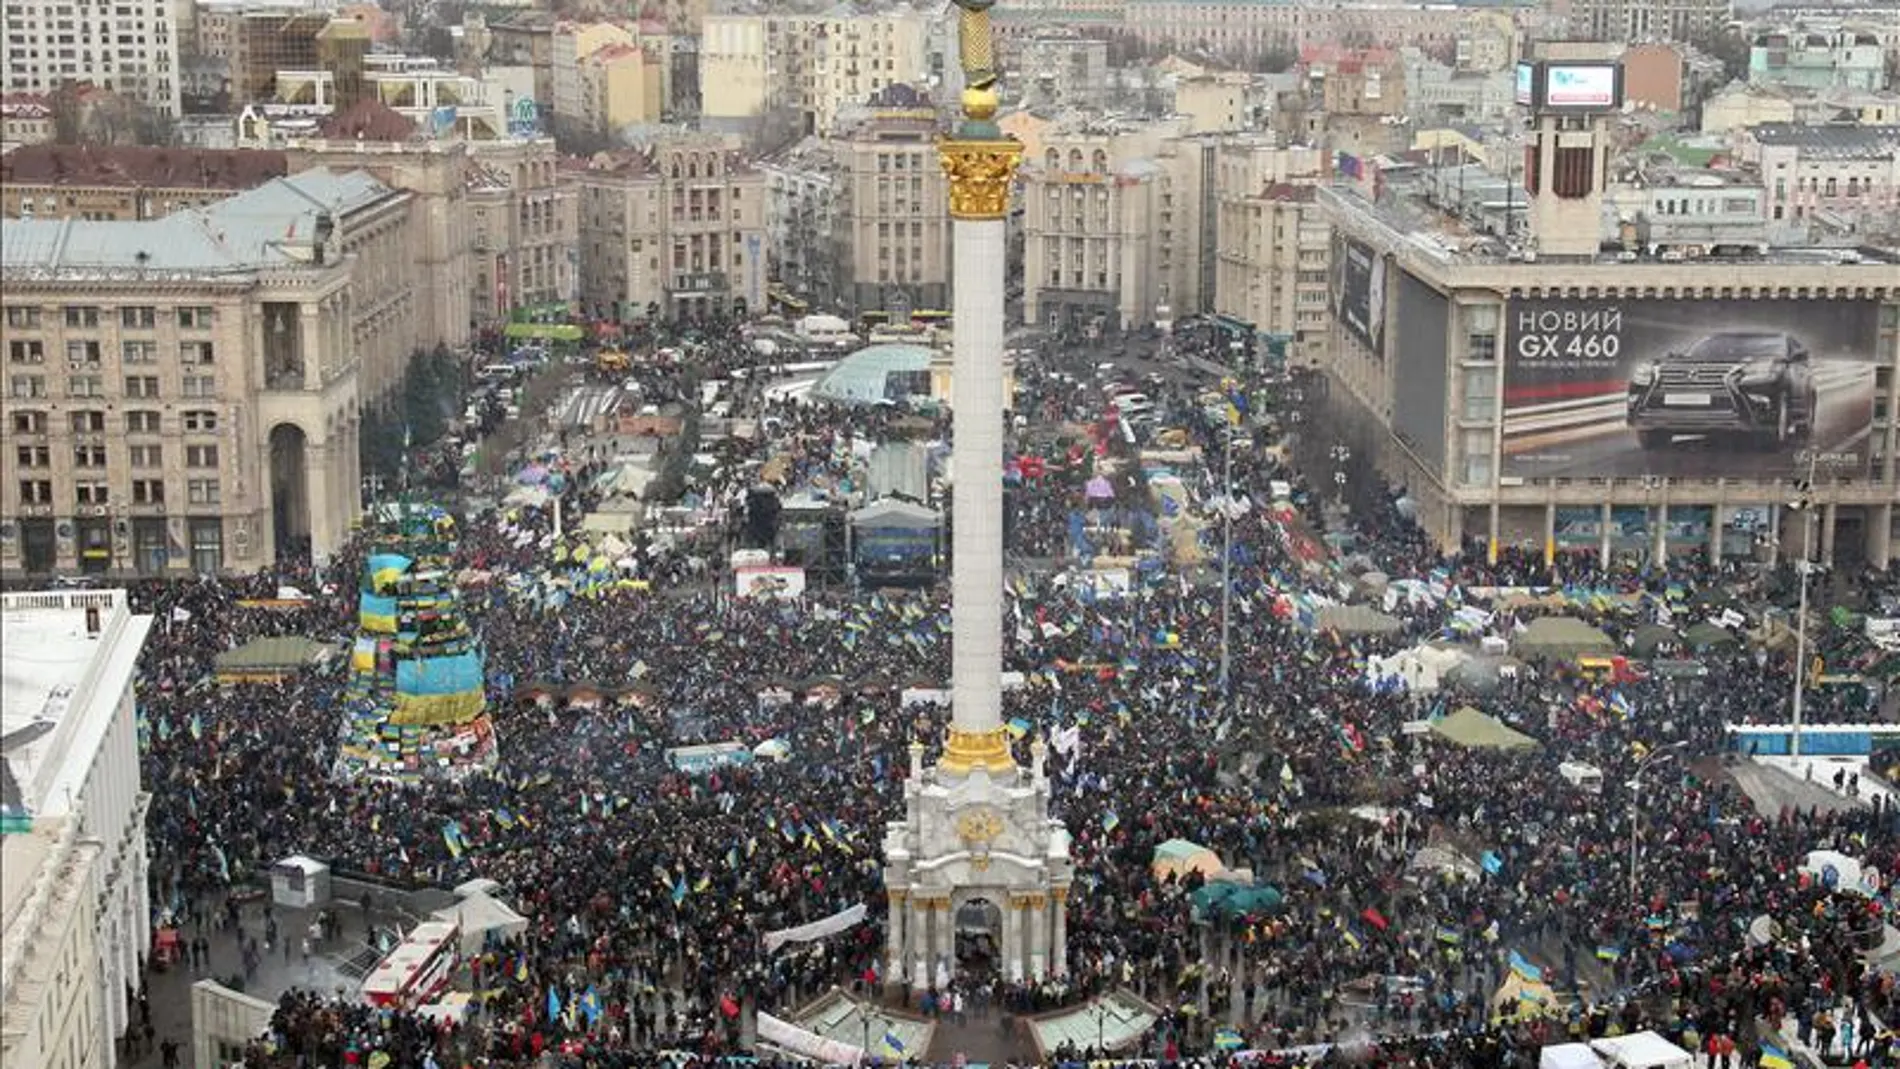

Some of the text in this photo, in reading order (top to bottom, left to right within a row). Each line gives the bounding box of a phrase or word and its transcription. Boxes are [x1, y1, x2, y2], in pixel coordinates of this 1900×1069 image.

[1519, 307, 1621, 332] НОВИЙ
[1519, 335, 1619, 357] GX 460
